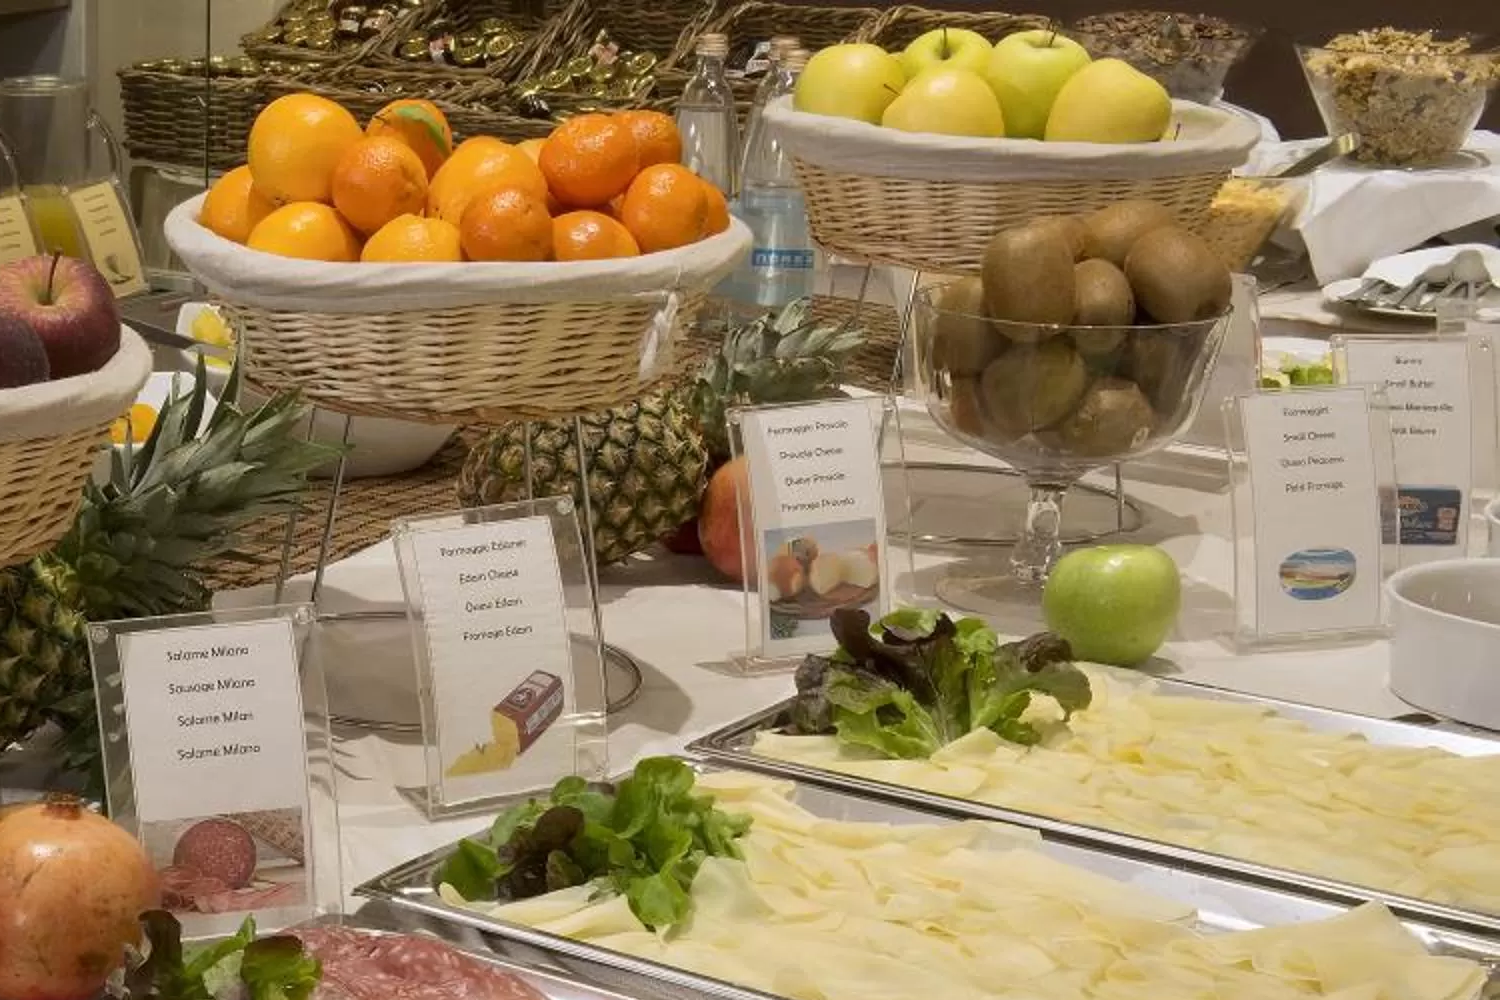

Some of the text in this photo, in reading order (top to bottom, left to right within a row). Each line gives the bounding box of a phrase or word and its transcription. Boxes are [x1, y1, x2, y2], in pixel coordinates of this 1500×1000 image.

[167, 645, 249, 663] Salame Milano
[168, 677, 256, 695] Sausage Milano
[177, 714, 220, 727] Salame
[177, 744, 261, 761] Salame Milano
